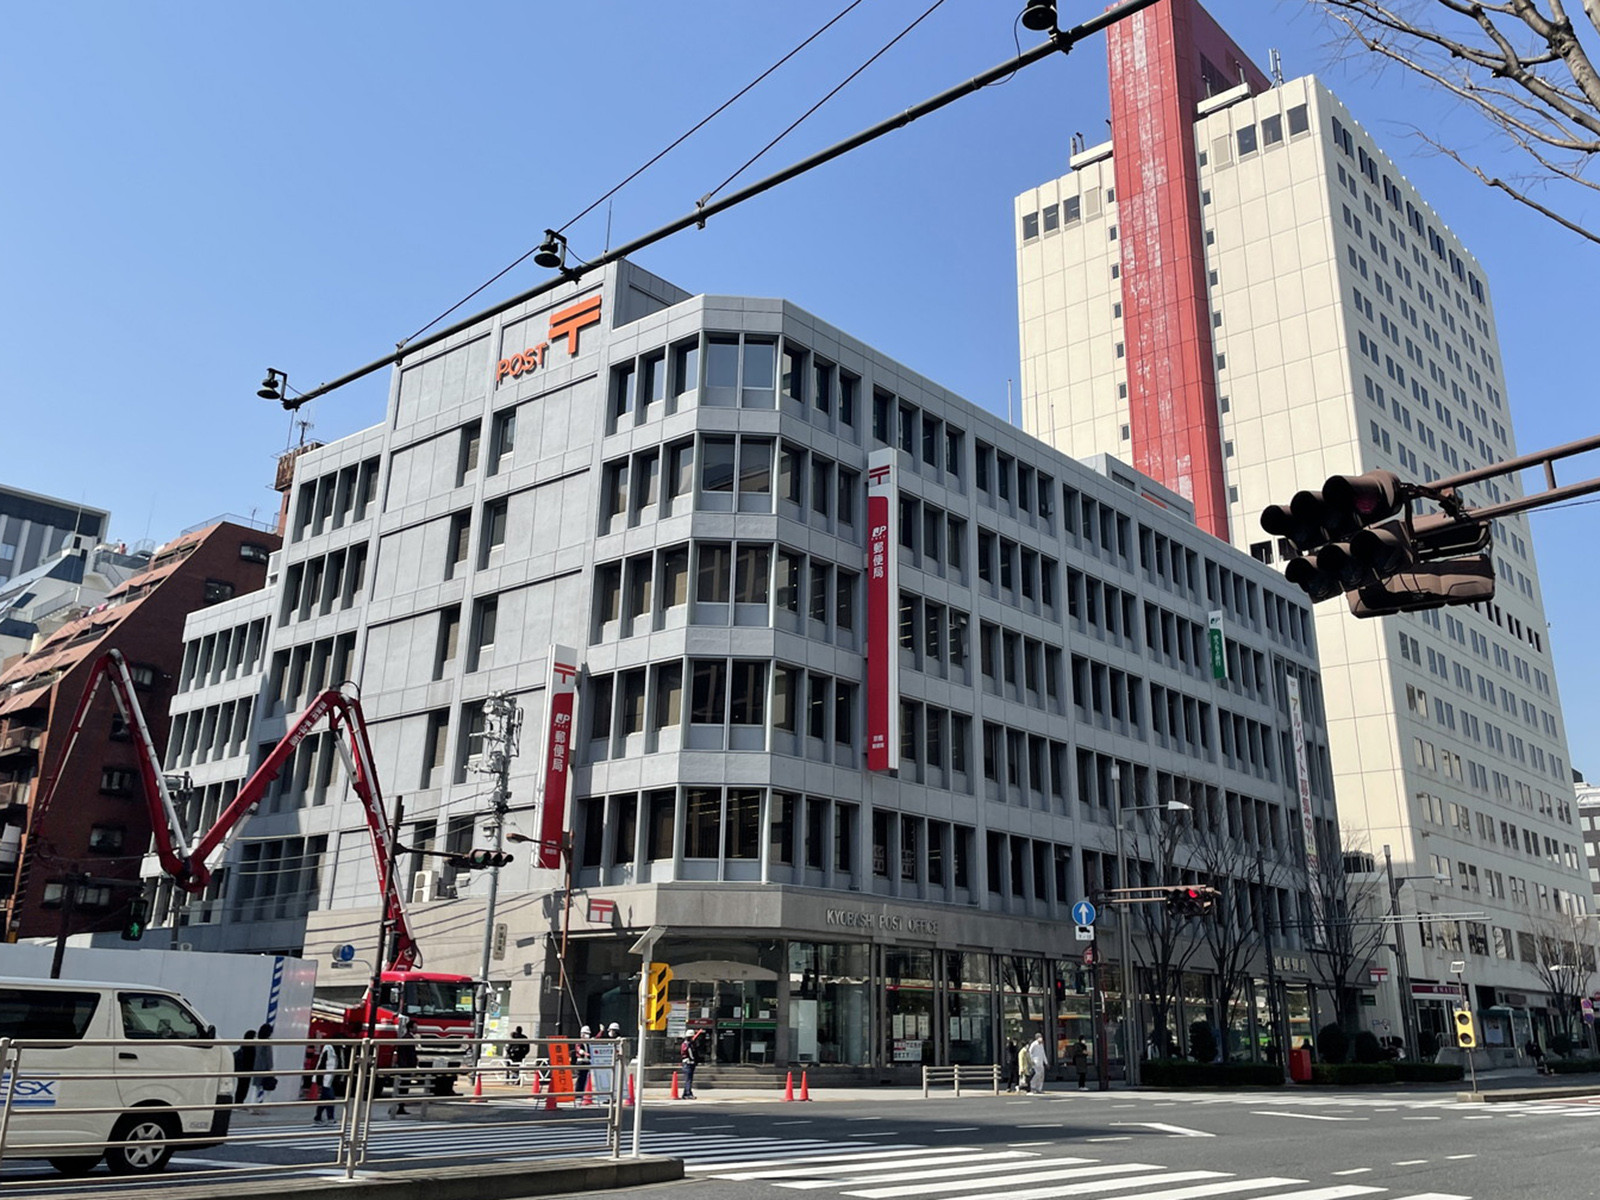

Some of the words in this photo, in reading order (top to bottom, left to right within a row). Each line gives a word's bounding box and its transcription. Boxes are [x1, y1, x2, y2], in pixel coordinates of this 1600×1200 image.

[496, 342, 548, 381] POST
[826, 909, 876, 928] KYOBASHI
[879, 914, 903, 931] POST
[907, 919, 939, 936] OFFICE
